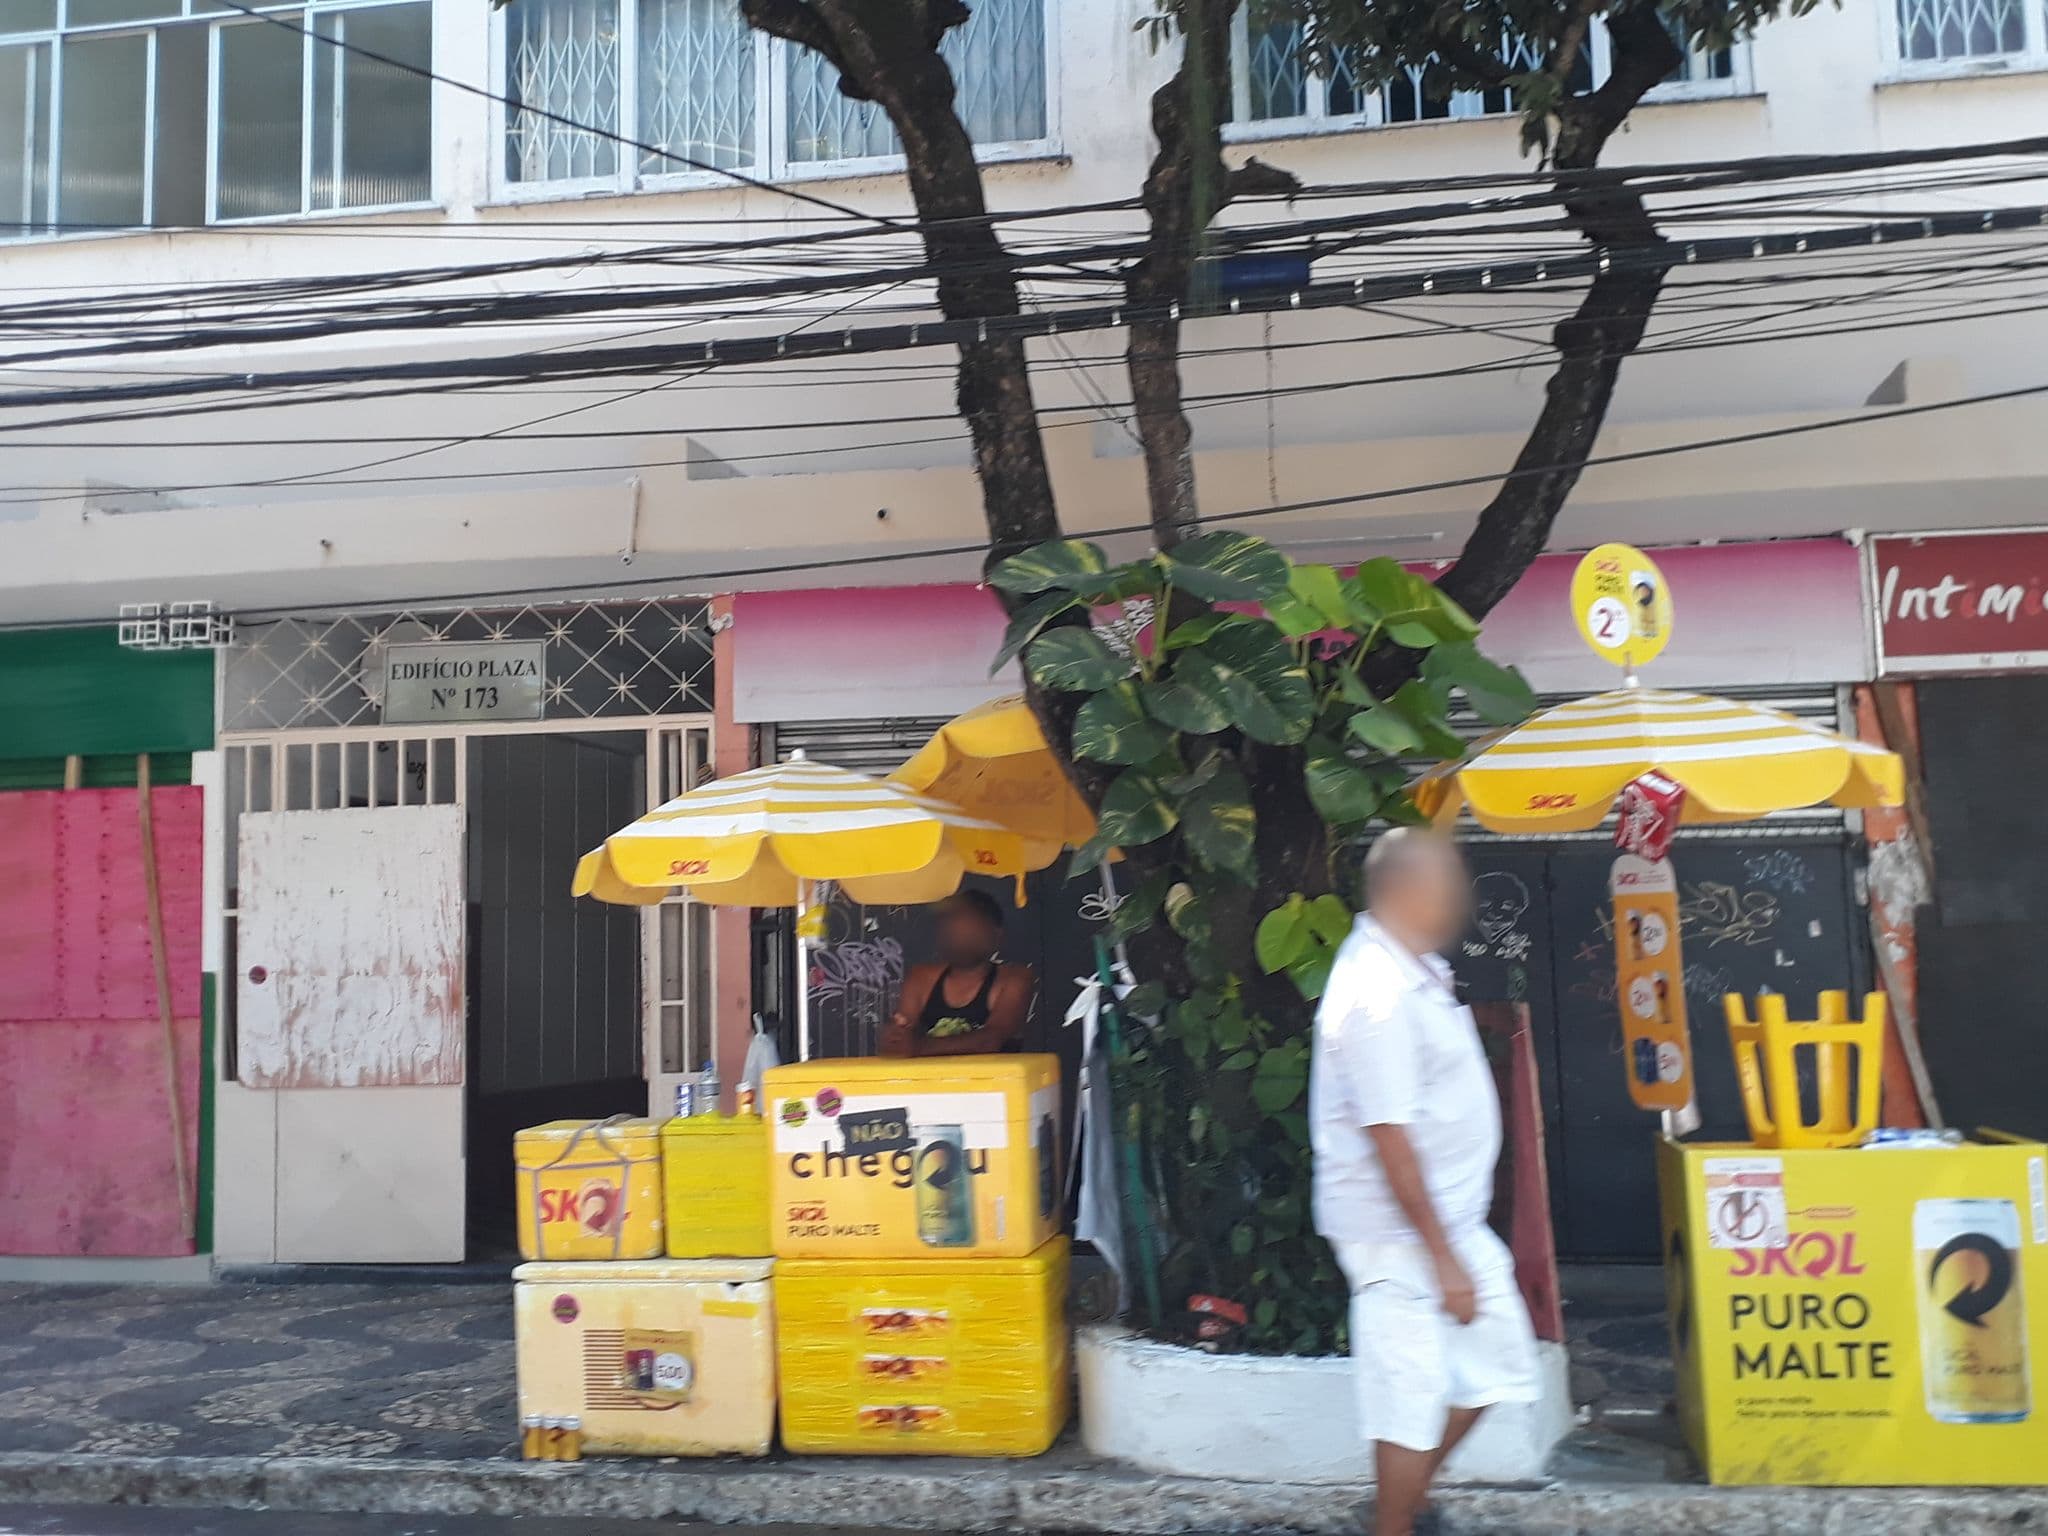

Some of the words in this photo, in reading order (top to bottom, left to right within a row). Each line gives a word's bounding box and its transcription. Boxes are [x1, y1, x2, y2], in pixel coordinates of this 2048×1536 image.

[1881, 566, 2048, 623] Intimi
[391, 658, 473, 681] EDIFÍCIO
[478, 659, 538, 677] PLAZA
[464, 686, 499, 710] 173
[1523, 792, 1578, 811] SKOL
[666, 858, 712, 876] SKOL
[849, 1117, 904, 1144] NÃO
[786, 1206, 830, 1222] SKOL
[787, 1224, 831, 1238] PURO
[832, 1222, 881, 1238] MALTE
[1728, 1230, 1867, 1279] SKOL
[1729, 1293, 1870, 1331] PURO
[1733, 1342, 1895, 1381] MALTE
